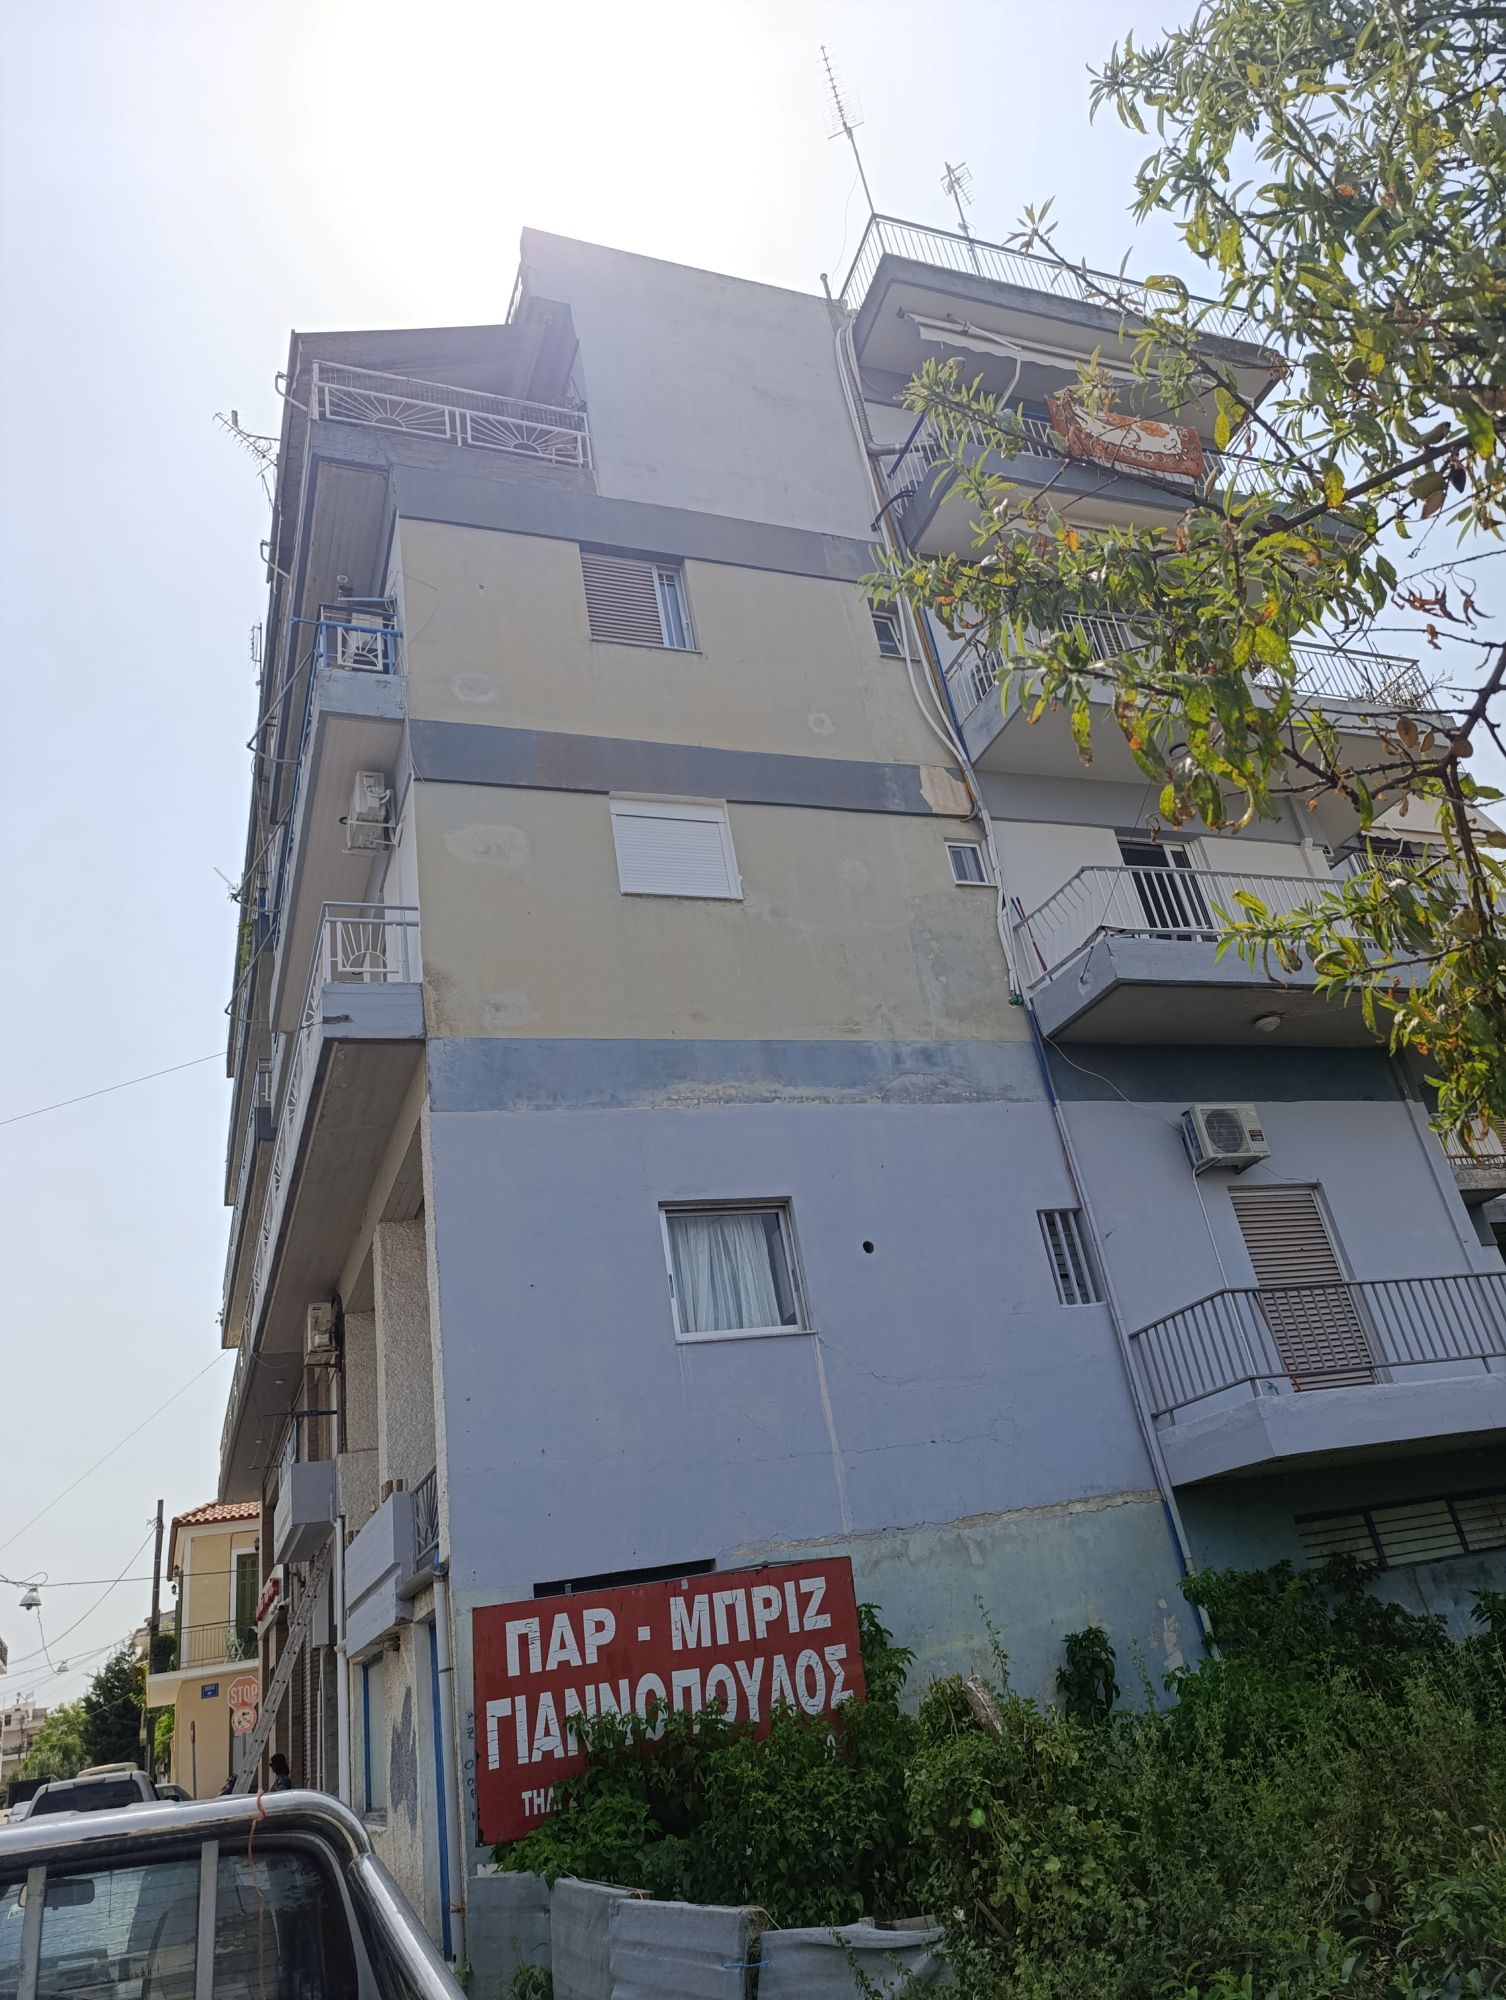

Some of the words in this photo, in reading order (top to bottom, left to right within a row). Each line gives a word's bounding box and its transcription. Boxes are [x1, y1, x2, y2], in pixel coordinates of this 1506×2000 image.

[505, 1607, 616, 1677] ΠΑΡ
[669, 1576, 832, 1651] ΜΠΡΙΖ
[230, 1683, 259, 1705] STOP
